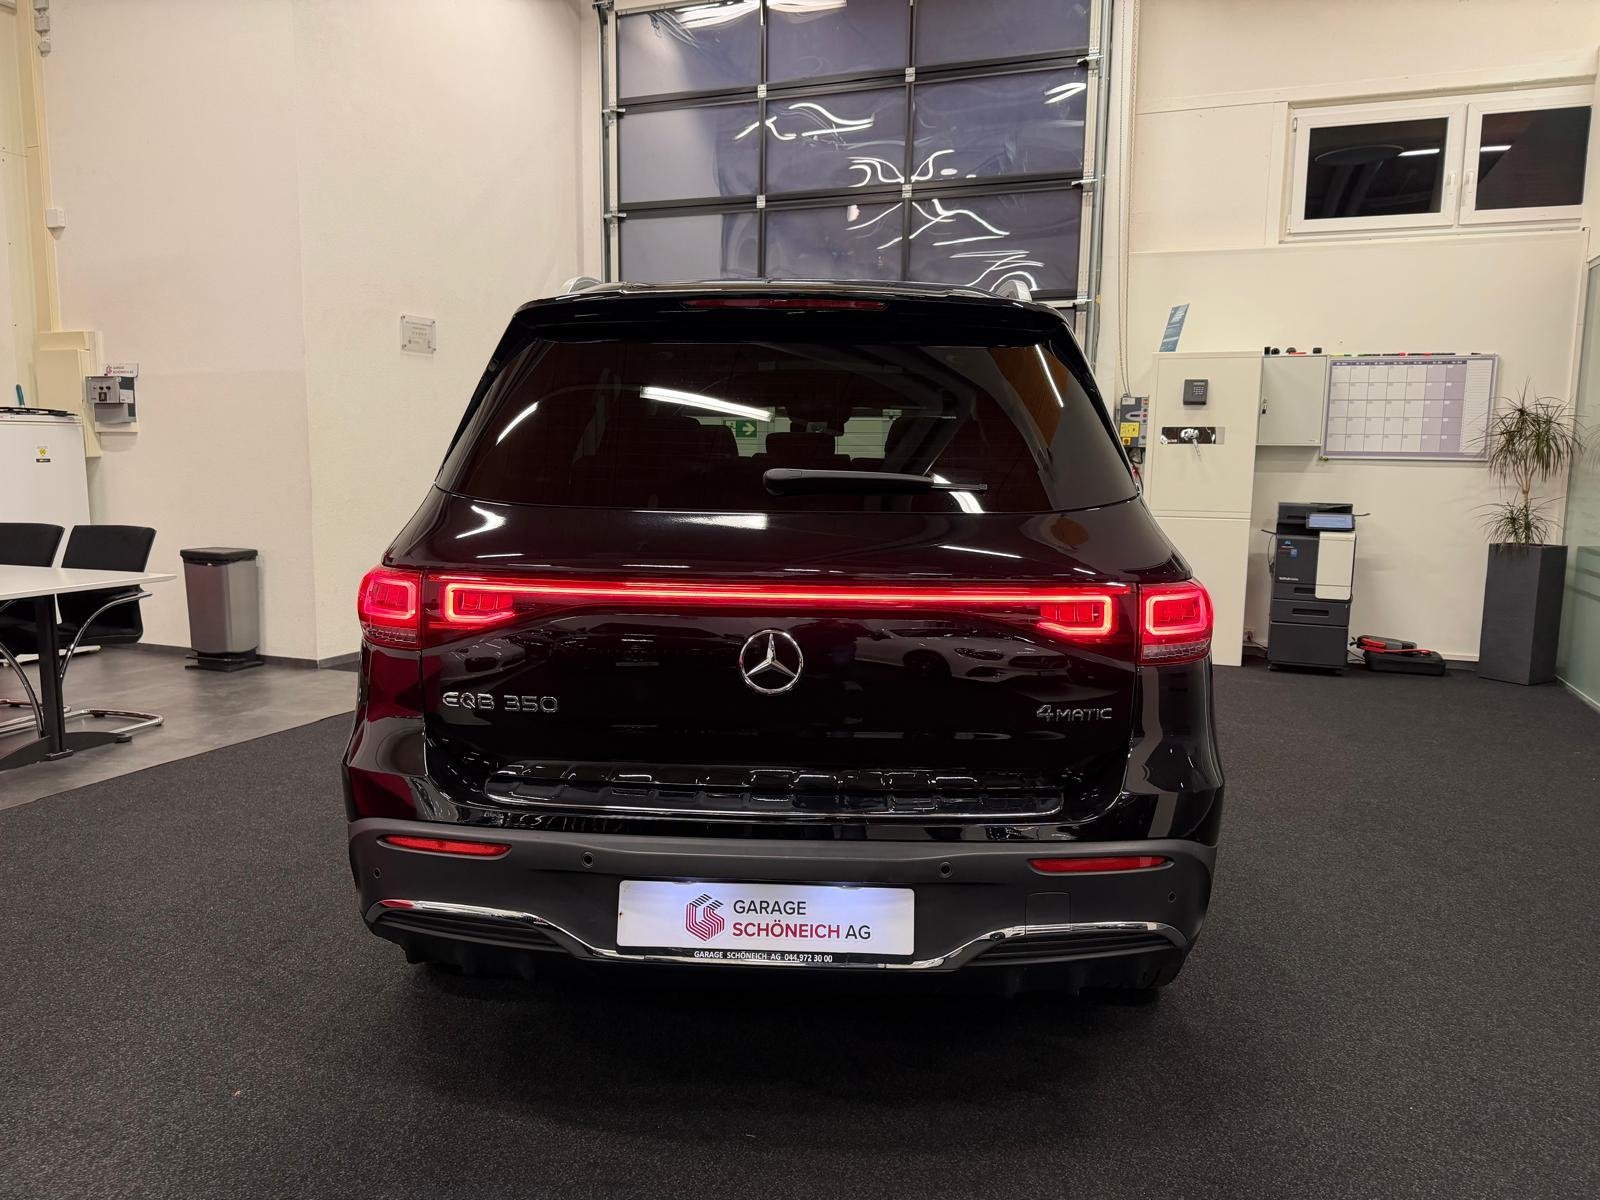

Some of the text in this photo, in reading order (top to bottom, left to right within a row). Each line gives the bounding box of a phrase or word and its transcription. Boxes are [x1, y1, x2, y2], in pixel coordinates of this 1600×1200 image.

[442, 691, 559, 713] EQB 350
[1036, 704, 1113, 722] 4MATIC
[733, 899, 807, 915] GARAGE
[732, 919, 872, 940] SCHÖNEICH AG
[693, 950, 724, 959] GARAGE
[770, 952, 781, 961] AG
[813, 954, 823, 962] 30
[823, 954, 833, 963] 00
